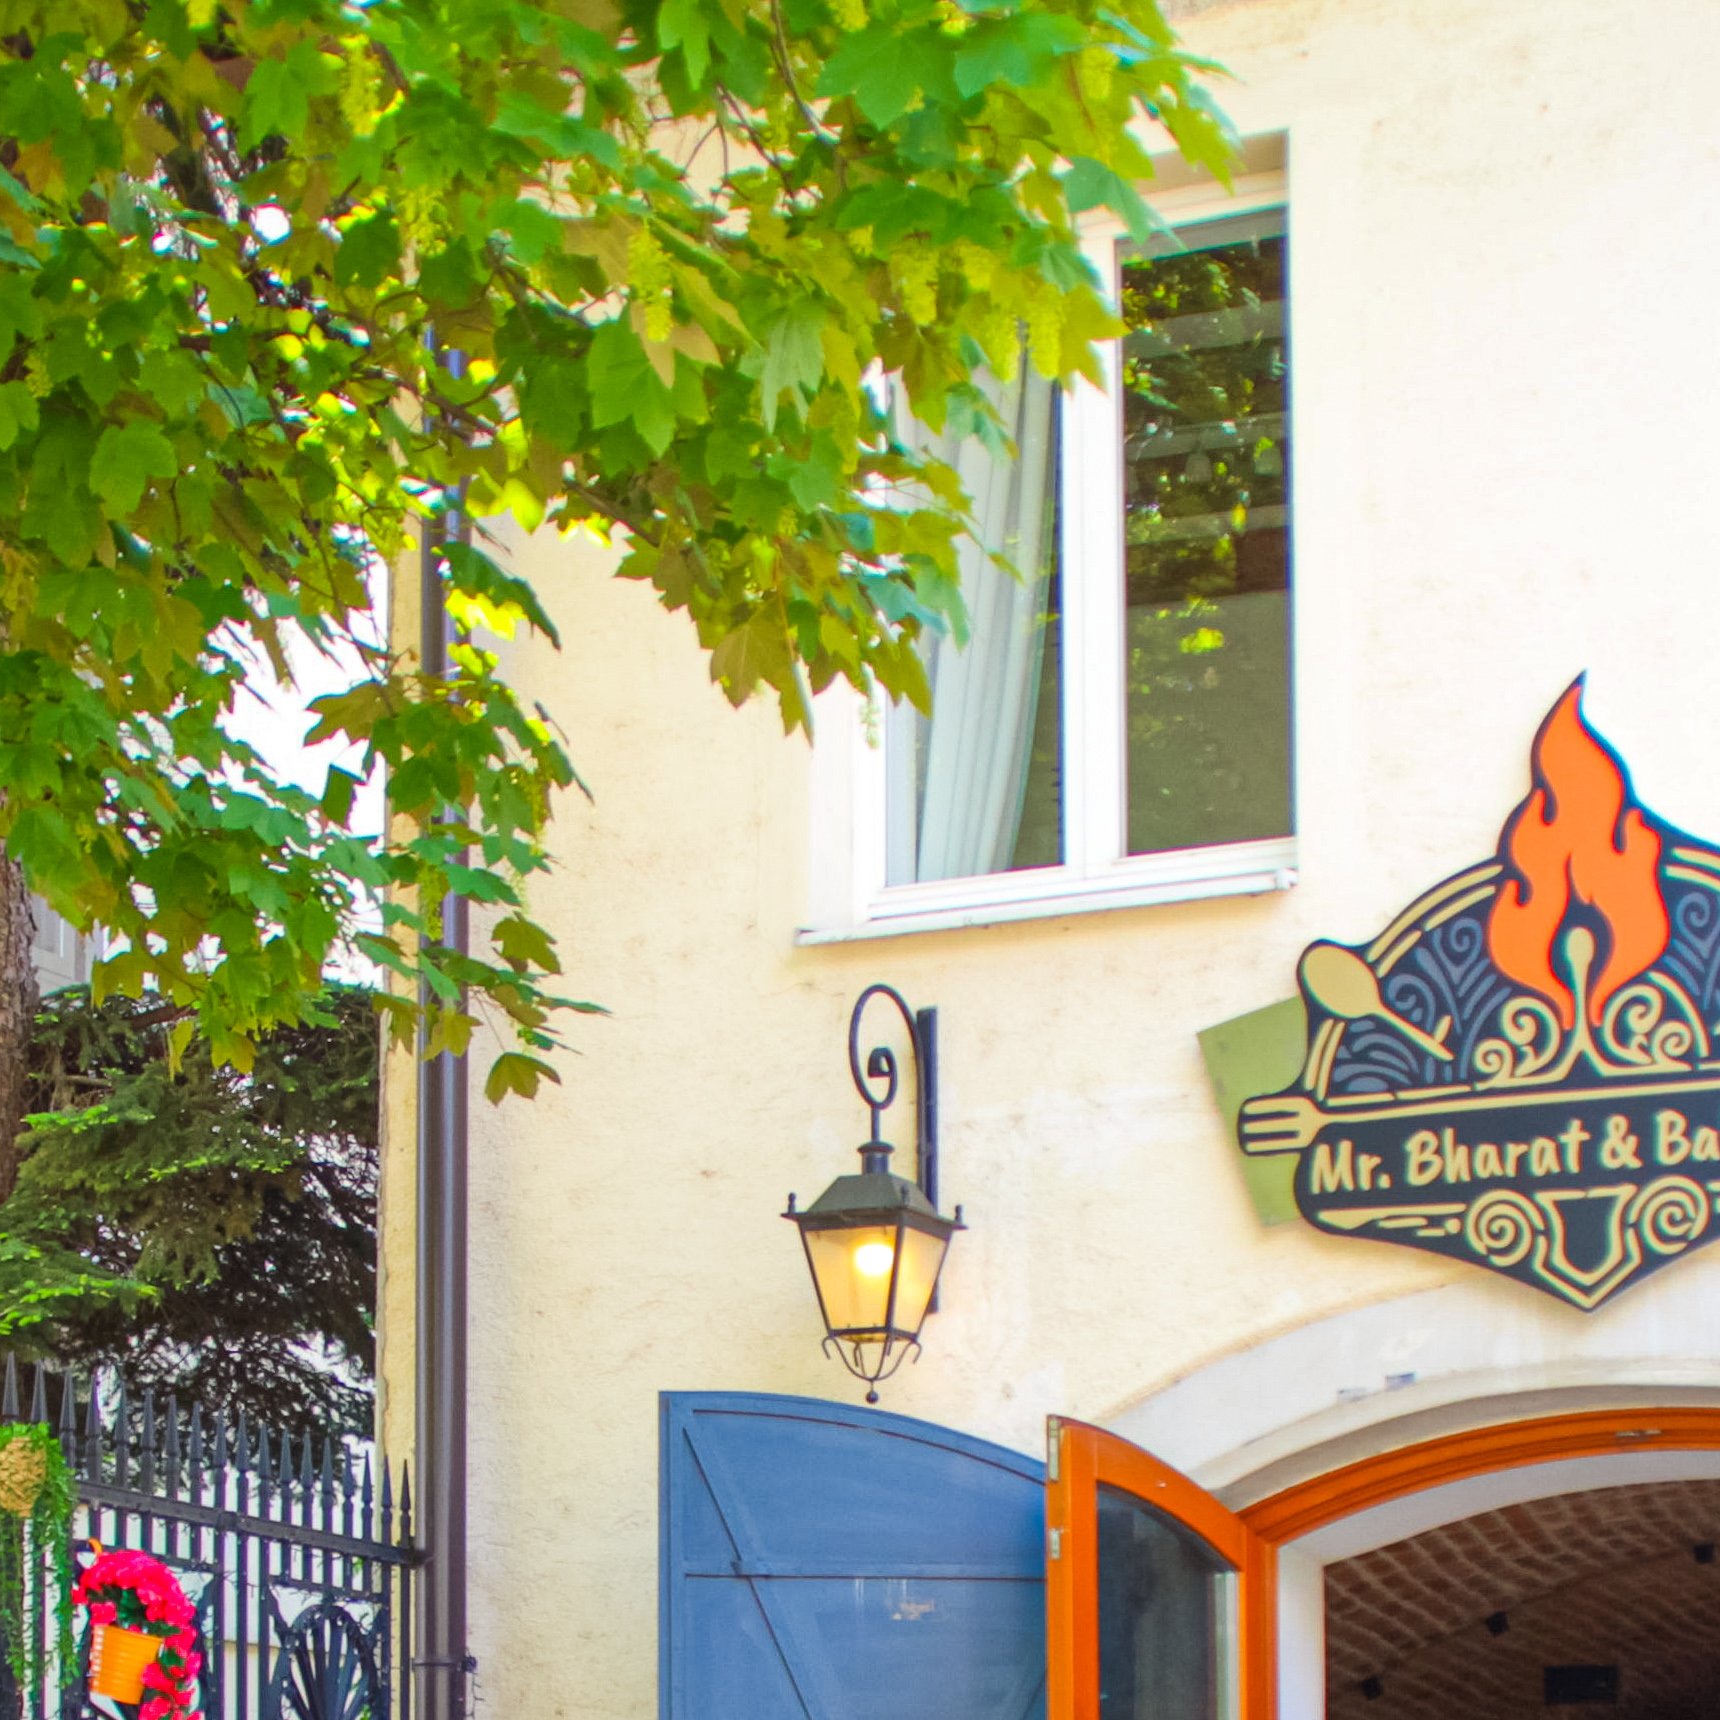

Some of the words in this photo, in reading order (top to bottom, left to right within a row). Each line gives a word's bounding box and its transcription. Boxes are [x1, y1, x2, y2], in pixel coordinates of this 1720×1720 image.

[1309, 1139, 1391, 1195] Mr.
[1404, 1119, 1591, 1187] Bharat
[1600, 1114, 1643, 1170] &
